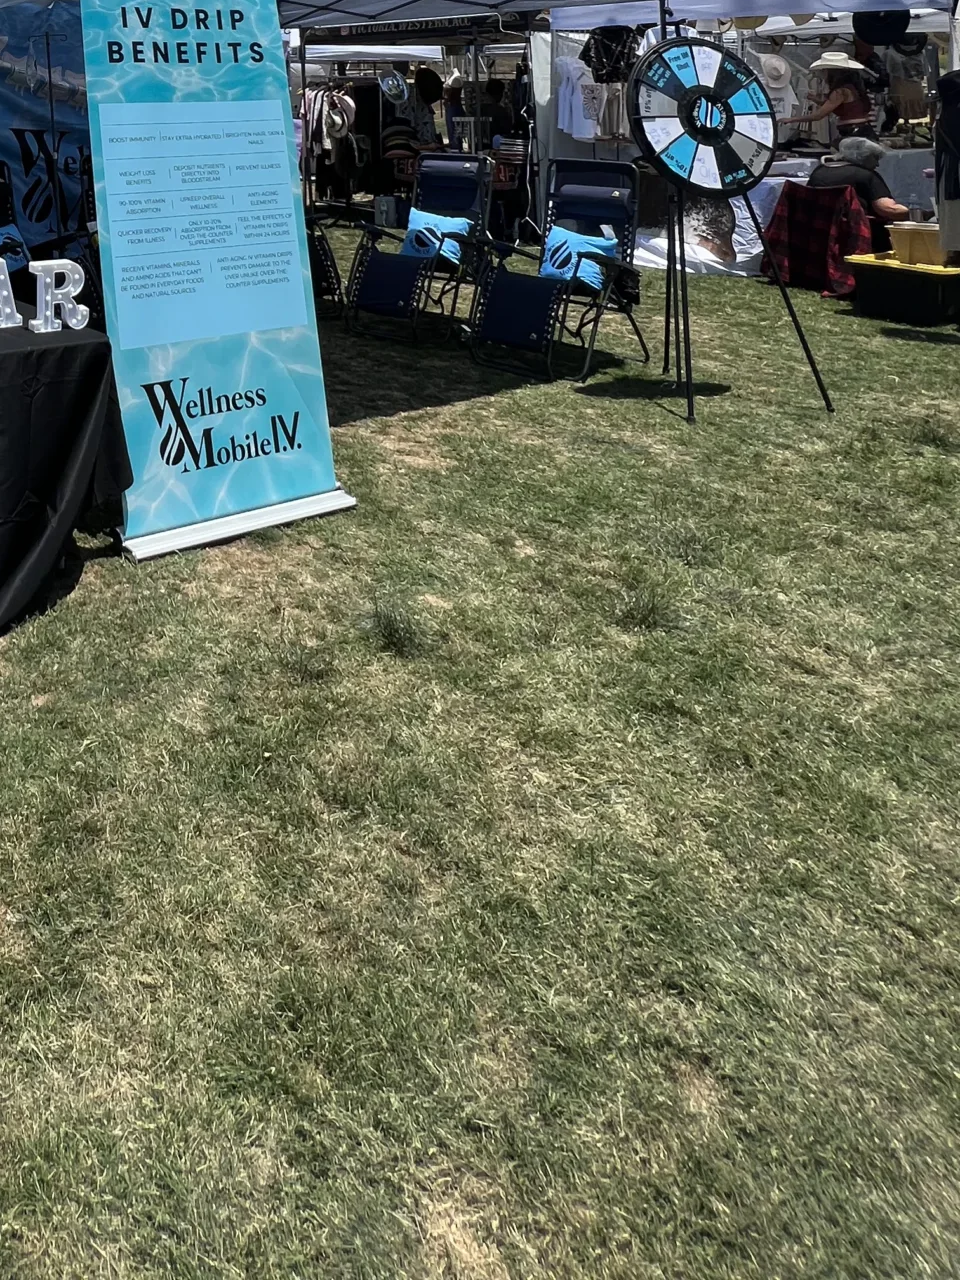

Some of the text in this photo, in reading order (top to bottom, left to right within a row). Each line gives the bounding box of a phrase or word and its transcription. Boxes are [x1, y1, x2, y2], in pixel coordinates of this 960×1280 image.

[121, 7, 244, 31] IV DRIP
[107, 41, 265, 64] BENEFITS
[181, 176, 221, 184] BLOODSTREAM
[277, 250, 292, 258] DRIPS
[220, 264, 248, 272] PREVENTS
[156, 280, 184, 288] EVERYDAY
[252, 276, 290, 286] SUPPLEMENTS
[145, 290, 170, 298] NATURAL
[170, 287, 196, 295] SOURCES
[140, 377, 267, 428] Wellness
[181, 426, 271, 473] Mobile
